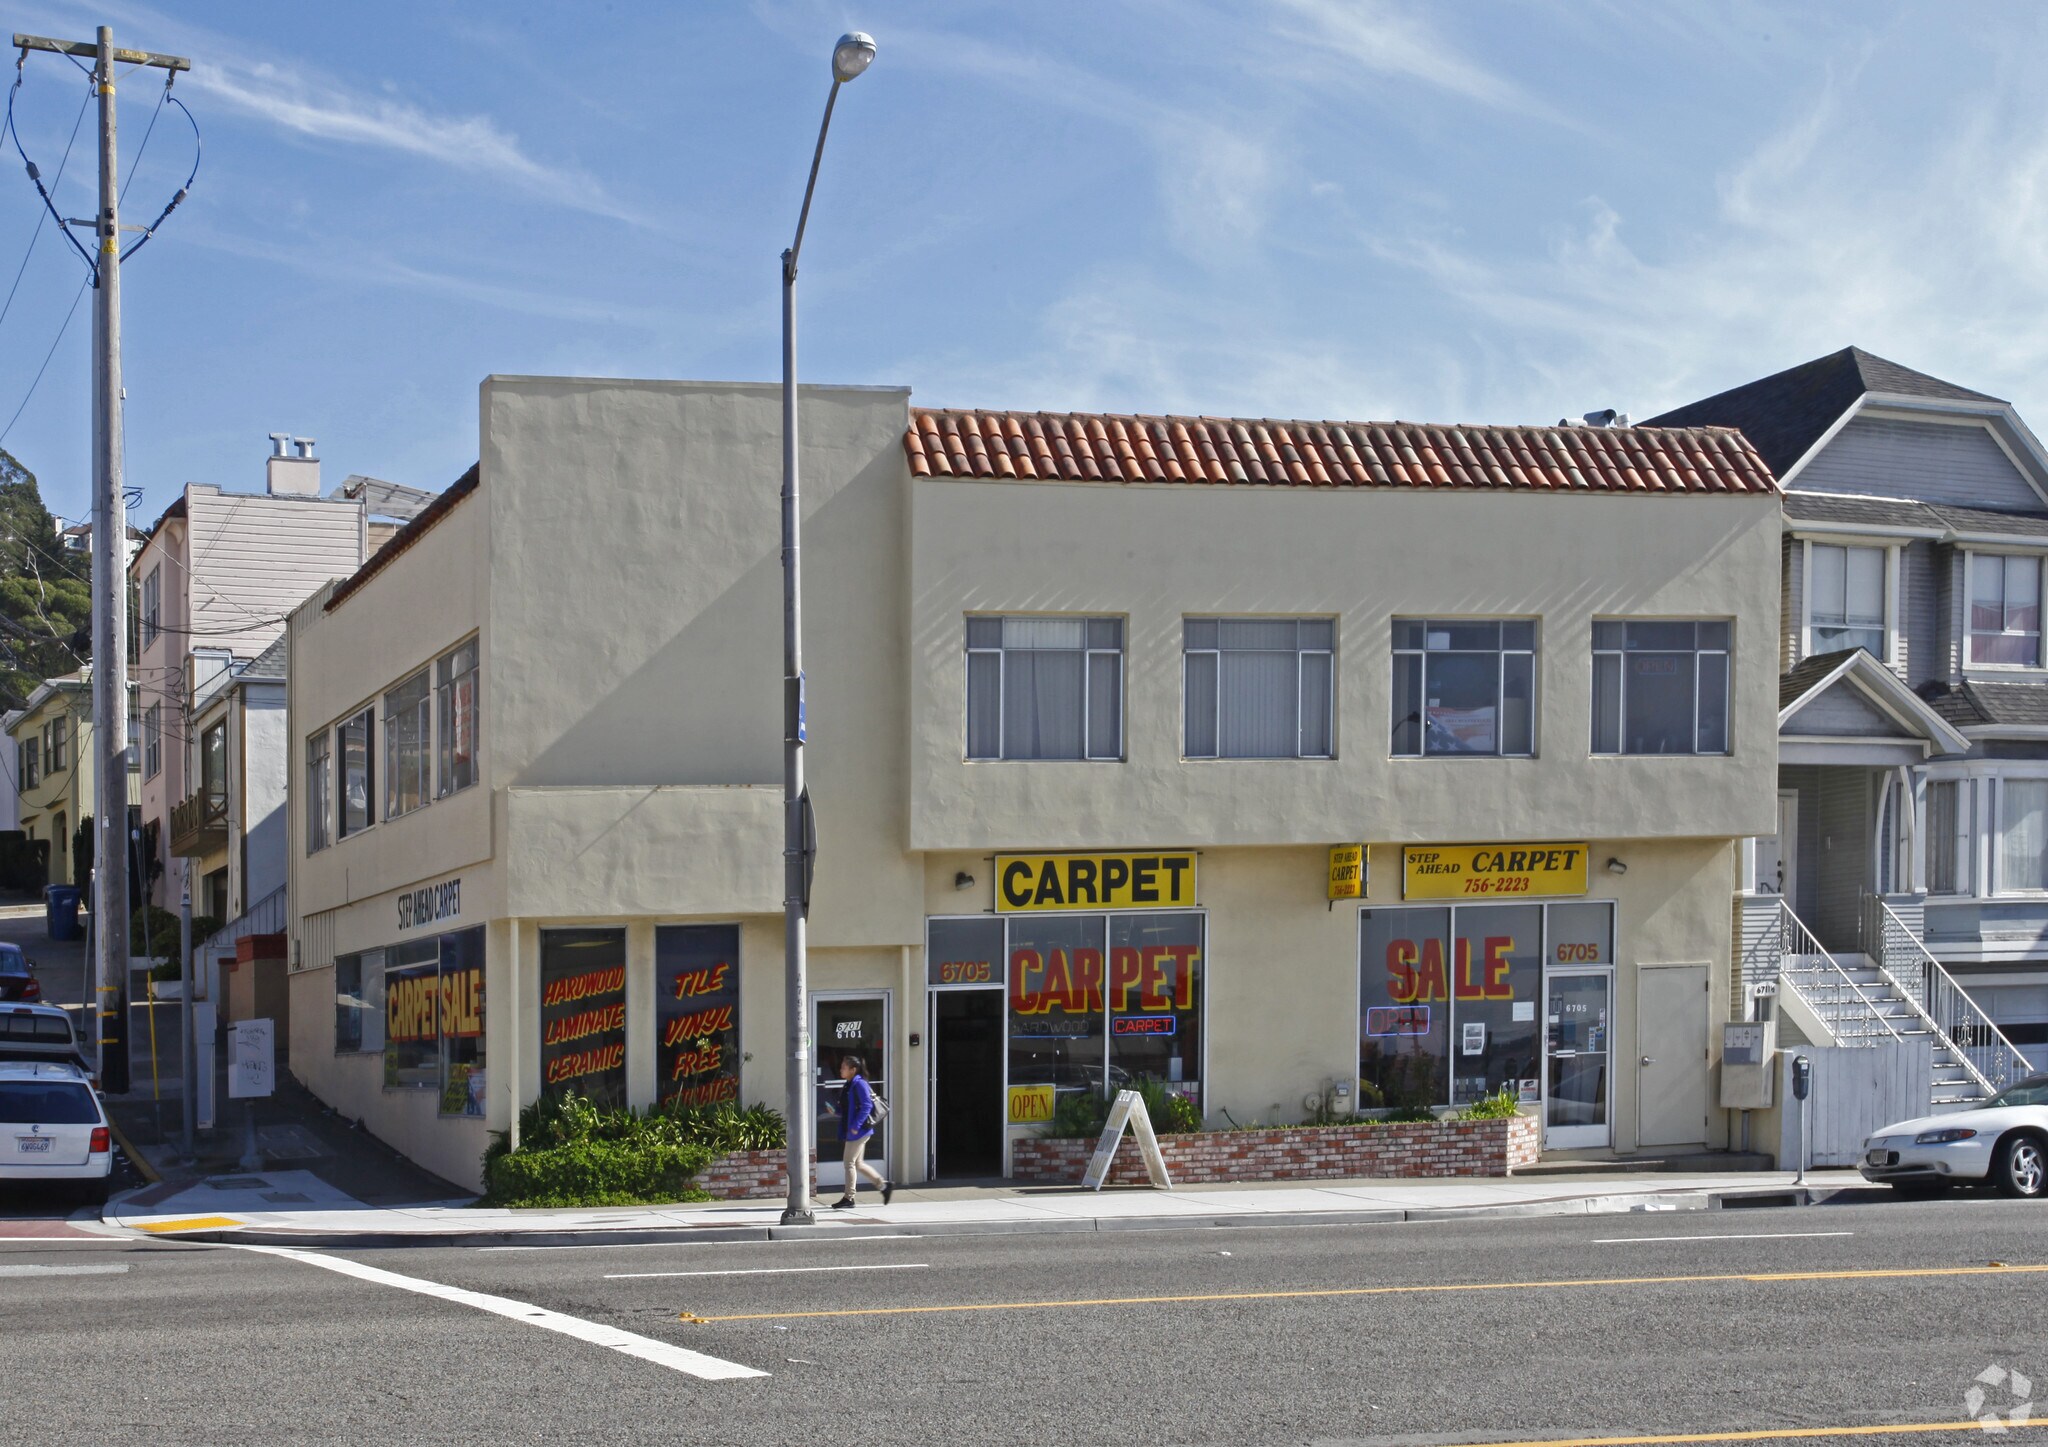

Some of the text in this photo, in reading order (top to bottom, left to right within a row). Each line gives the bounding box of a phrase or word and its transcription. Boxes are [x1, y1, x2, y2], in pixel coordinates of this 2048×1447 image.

[1331, 865, 1358, 881] CARPET
[1408, 853, 1440, 863] STEP
[1416, 864, 1461, 875] AHEAD
[1472, 850, 1579, 873] CARPET
[1002, 857, 1190, 907] CARPET
[1464, 877, 1530, 893] 756-2223
[397, 878, 461, 930] STEP AHEAD CARPET
[1557, 943, 1599, 962] 6705
[674, 962, 730, 1000] TILE
[940, 961, 991, 982] 6705
[1010, 945, 1200, 1015] CARPET
[1385, 936, 1515, 1003] SALE
[543, 965, 625, 1007] HARDWOOD
[388, 968, 481, 1042] CARPET SALE
[1565, 1004, 1588, 1013] 6705
[544, 1002, 625, 1045] LAMINATE
[664, 1003, 733, 1047] VINYL
[837, 1022, 861, 1031] 6701
[837, 1030, 862, 1039] 6701
[1114, 1018, 1173, 1033] CARPET
[546, 1041, 625, 1084] CERAMIC
[672, 1044, 722, 1081] FREE
[661, 1074, 740, 1110] ETIMATES
[1012, 1093, 1049, 1118] OPEN
